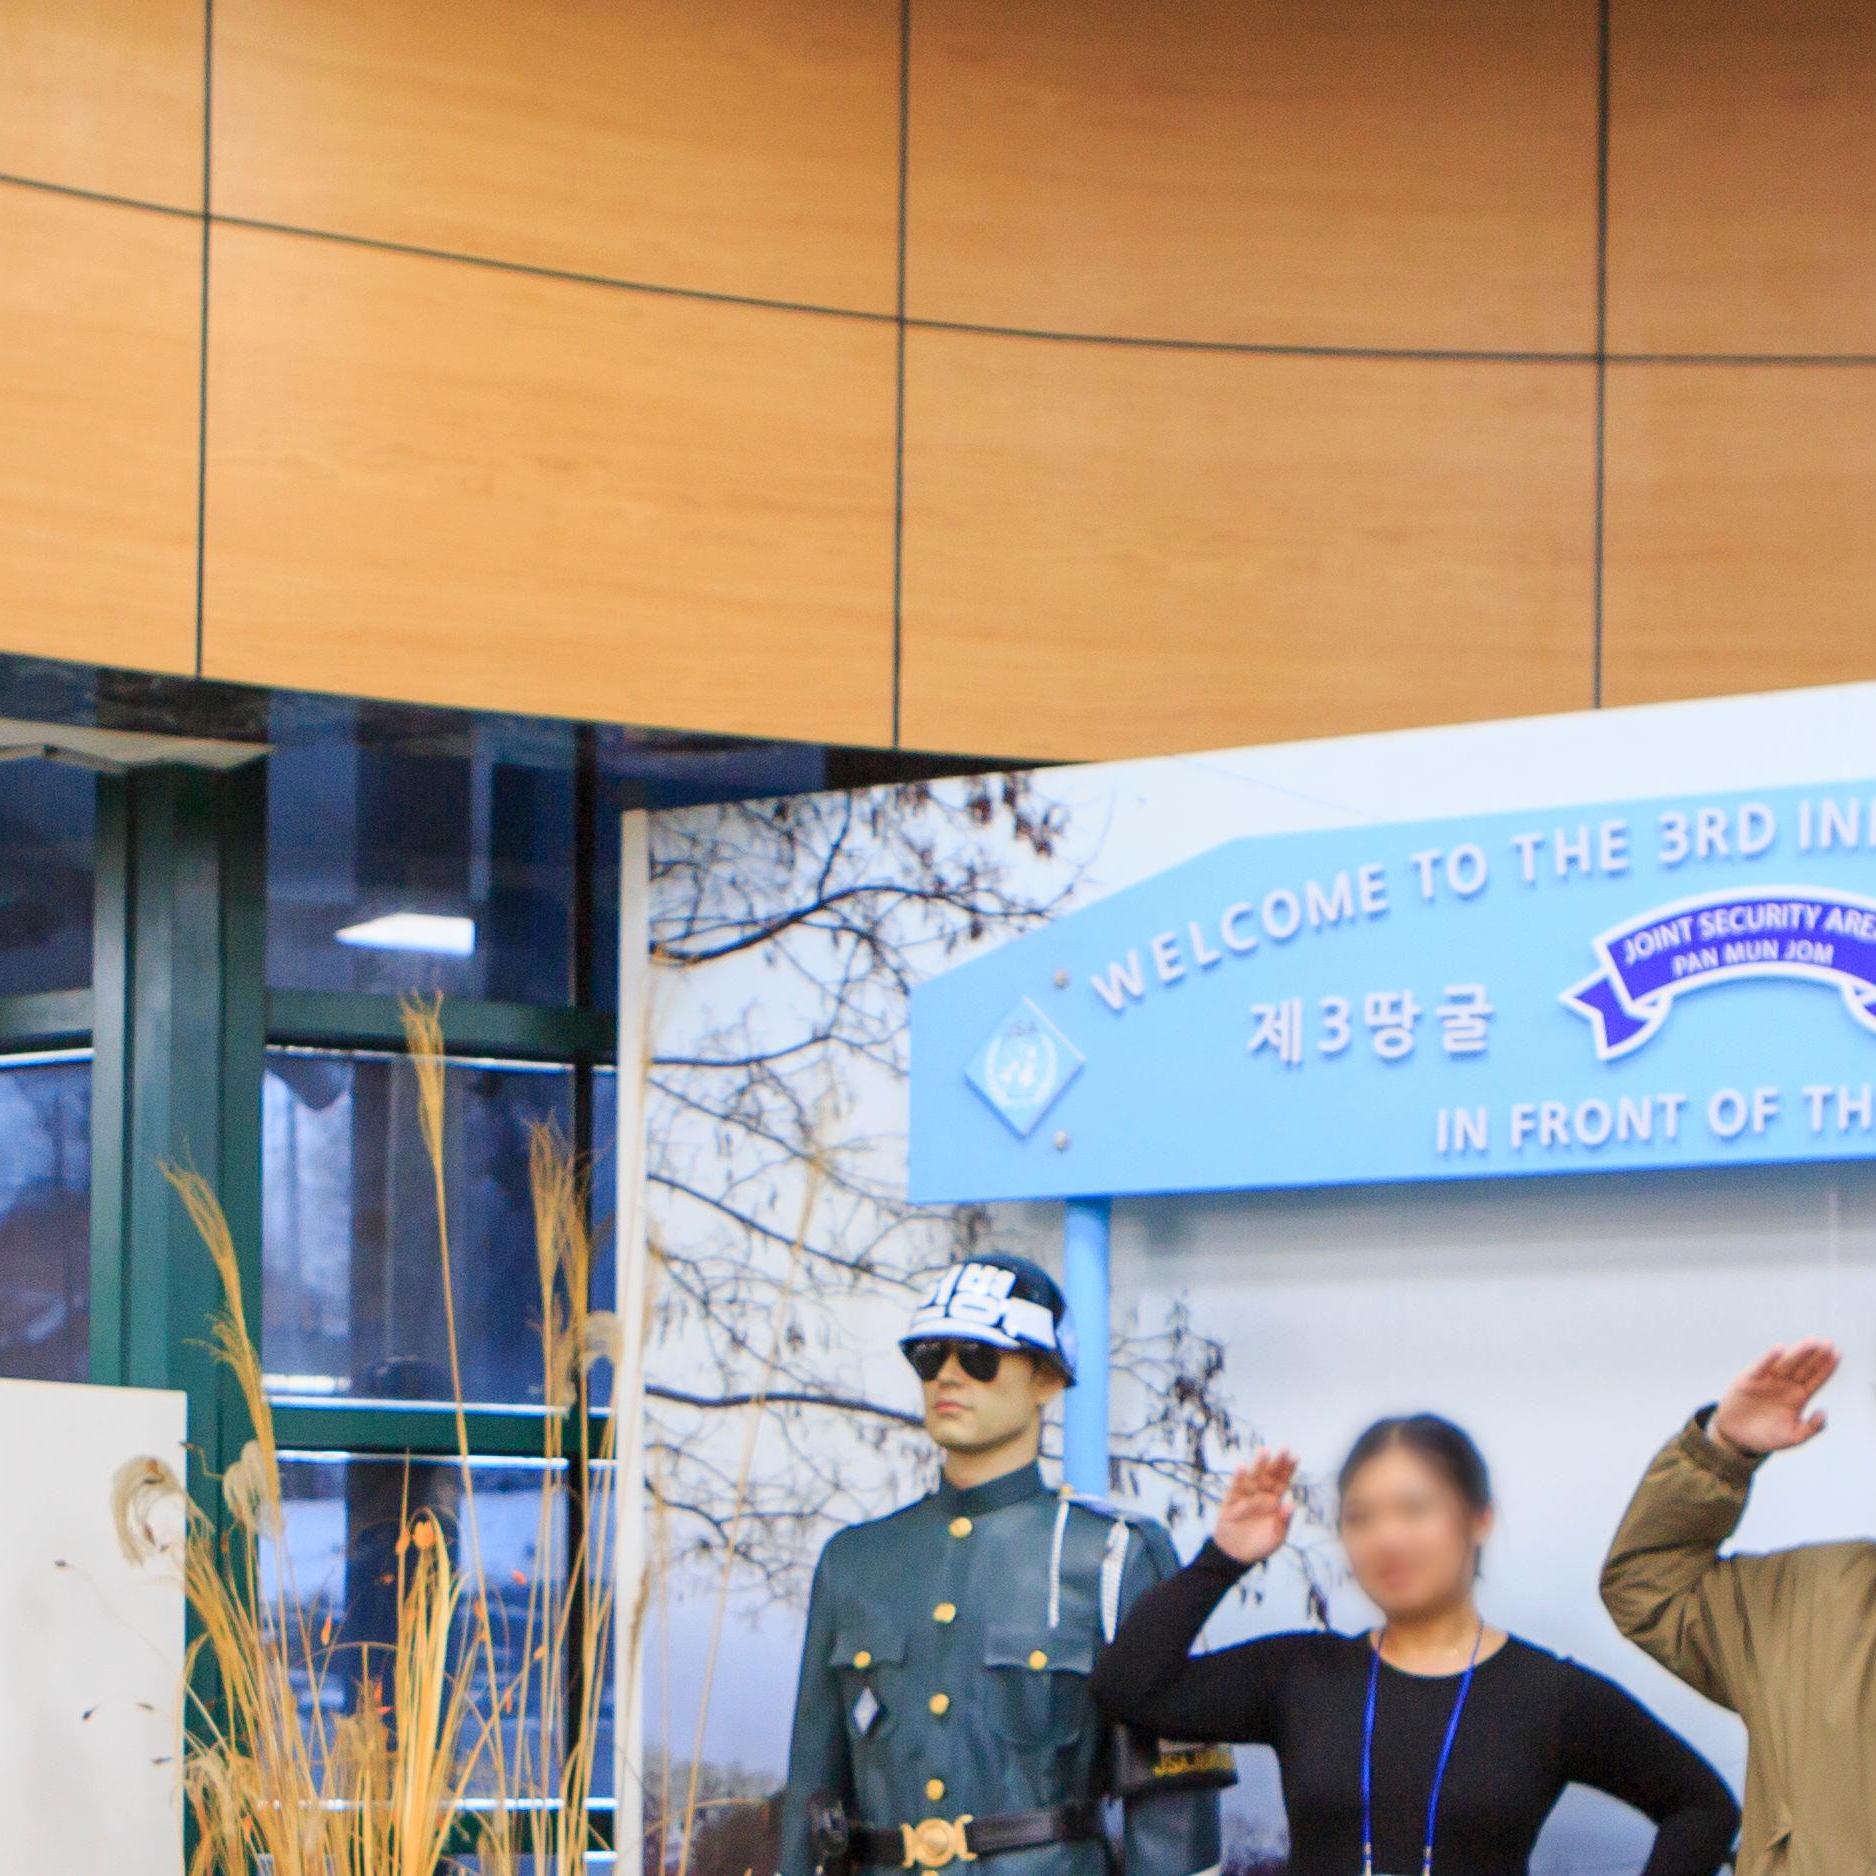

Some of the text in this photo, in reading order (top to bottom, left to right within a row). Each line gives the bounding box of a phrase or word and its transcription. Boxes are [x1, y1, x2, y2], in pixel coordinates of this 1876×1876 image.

[1090, 862, 1391, 1013] WELCOME
[1410, 842, 1489, 900] TO
[1513, 825, 1629, 887] THE
[1658, 804, 1778, 867] 3RD
[1622, 911, 1694, 964] JOINT
[1700, 900, 1823, 941] SECURITY
[1671, 940, 1835, 978] PAN MUN JOM
[1436, 1107, 1489, 1156] IN
[1509, 1091, 1688, 1150] FRONT
[1706, 1086, 1780, 1138] OF
